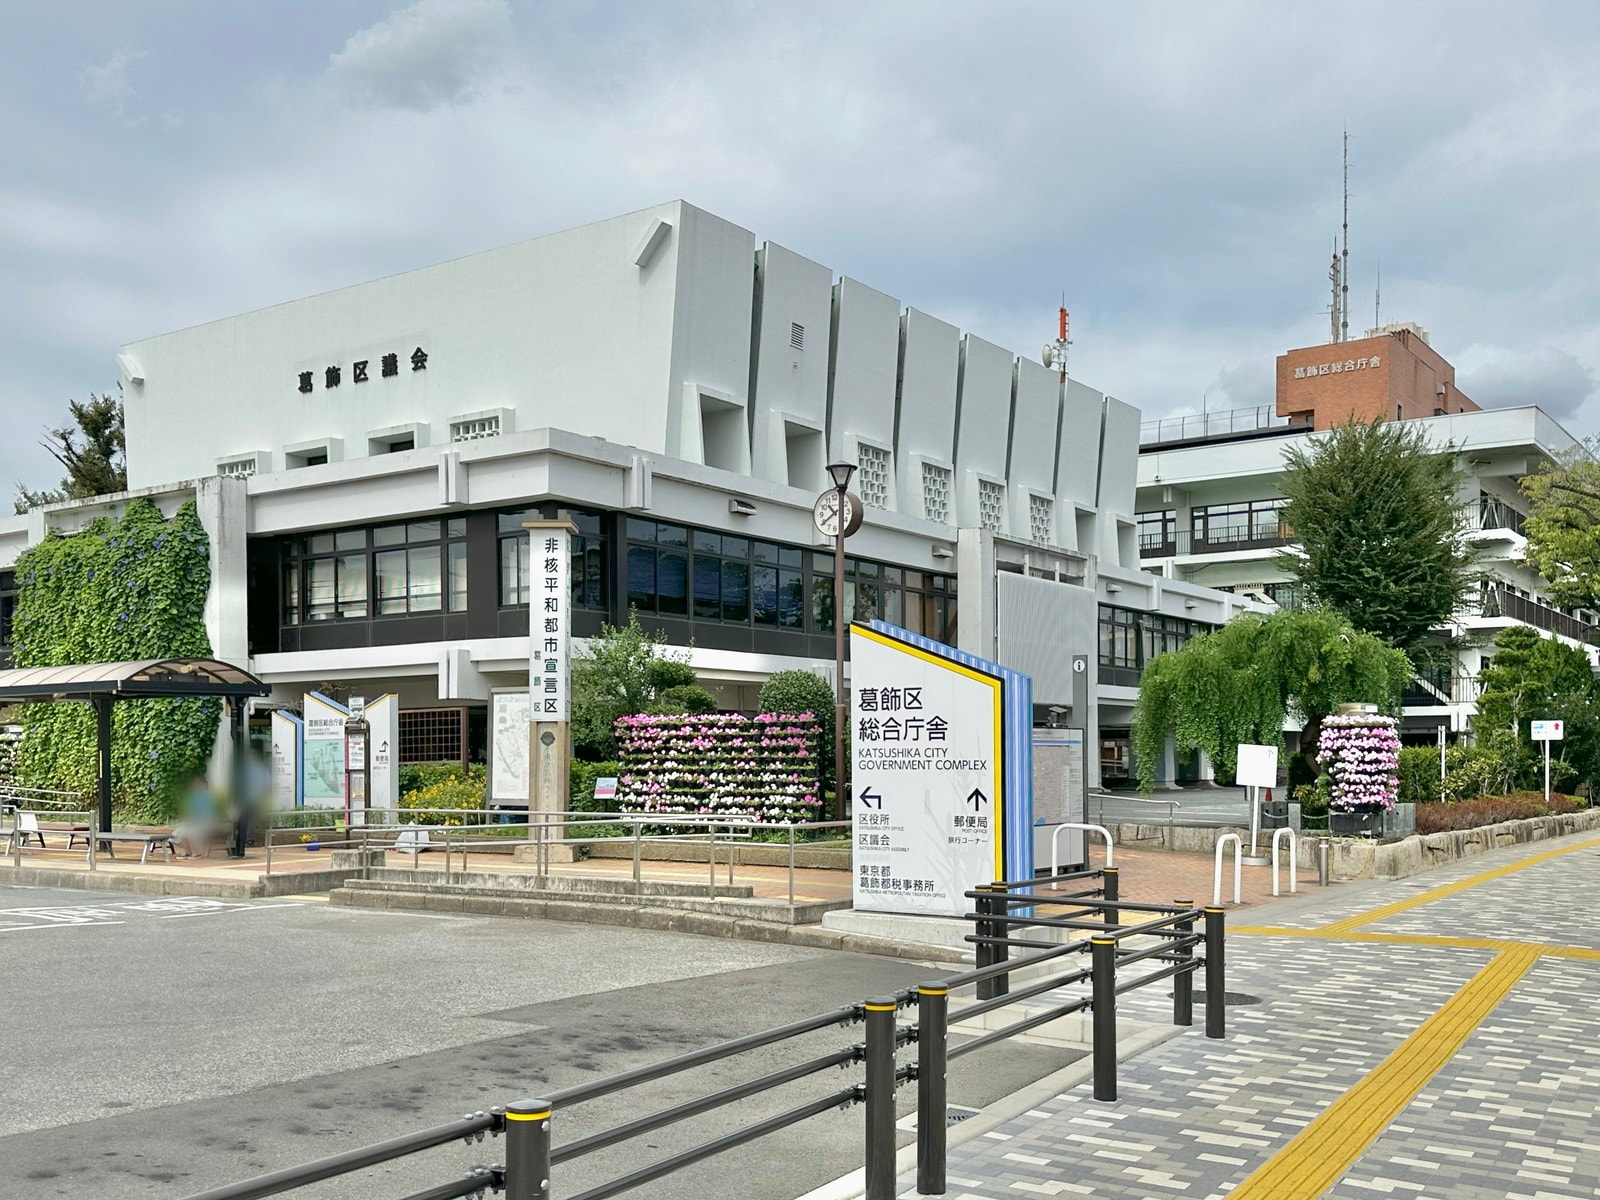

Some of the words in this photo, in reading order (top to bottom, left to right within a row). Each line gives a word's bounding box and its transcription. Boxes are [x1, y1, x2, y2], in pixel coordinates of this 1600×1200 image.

[298, 347, 428, 393] 葛飾区議会
[1294, 355, 1381, 379] 葛飾区総合庁舎
[544, 537, 559, 713] 非核平和都市宣言区
[859, 687, 923, 711] 葛飾区
[859, 715, 948, 741] 総合庁舎
[859, 748, 921, 758] KATSUSHIKA
[924, 748, 948, 758] CITY
[859, 760, 932, 770] GOVERNMENT
[935, 760, 987, 770] COMPLEX
[859, 814, 890, 826] 区役所
[954, 816, 988, 828] 郵便局
[859, 834, 890, 846] 区議会
[860, 865, 891, 877] 東京都
[860, 877, 934, 892] 葛飾都税事務所
